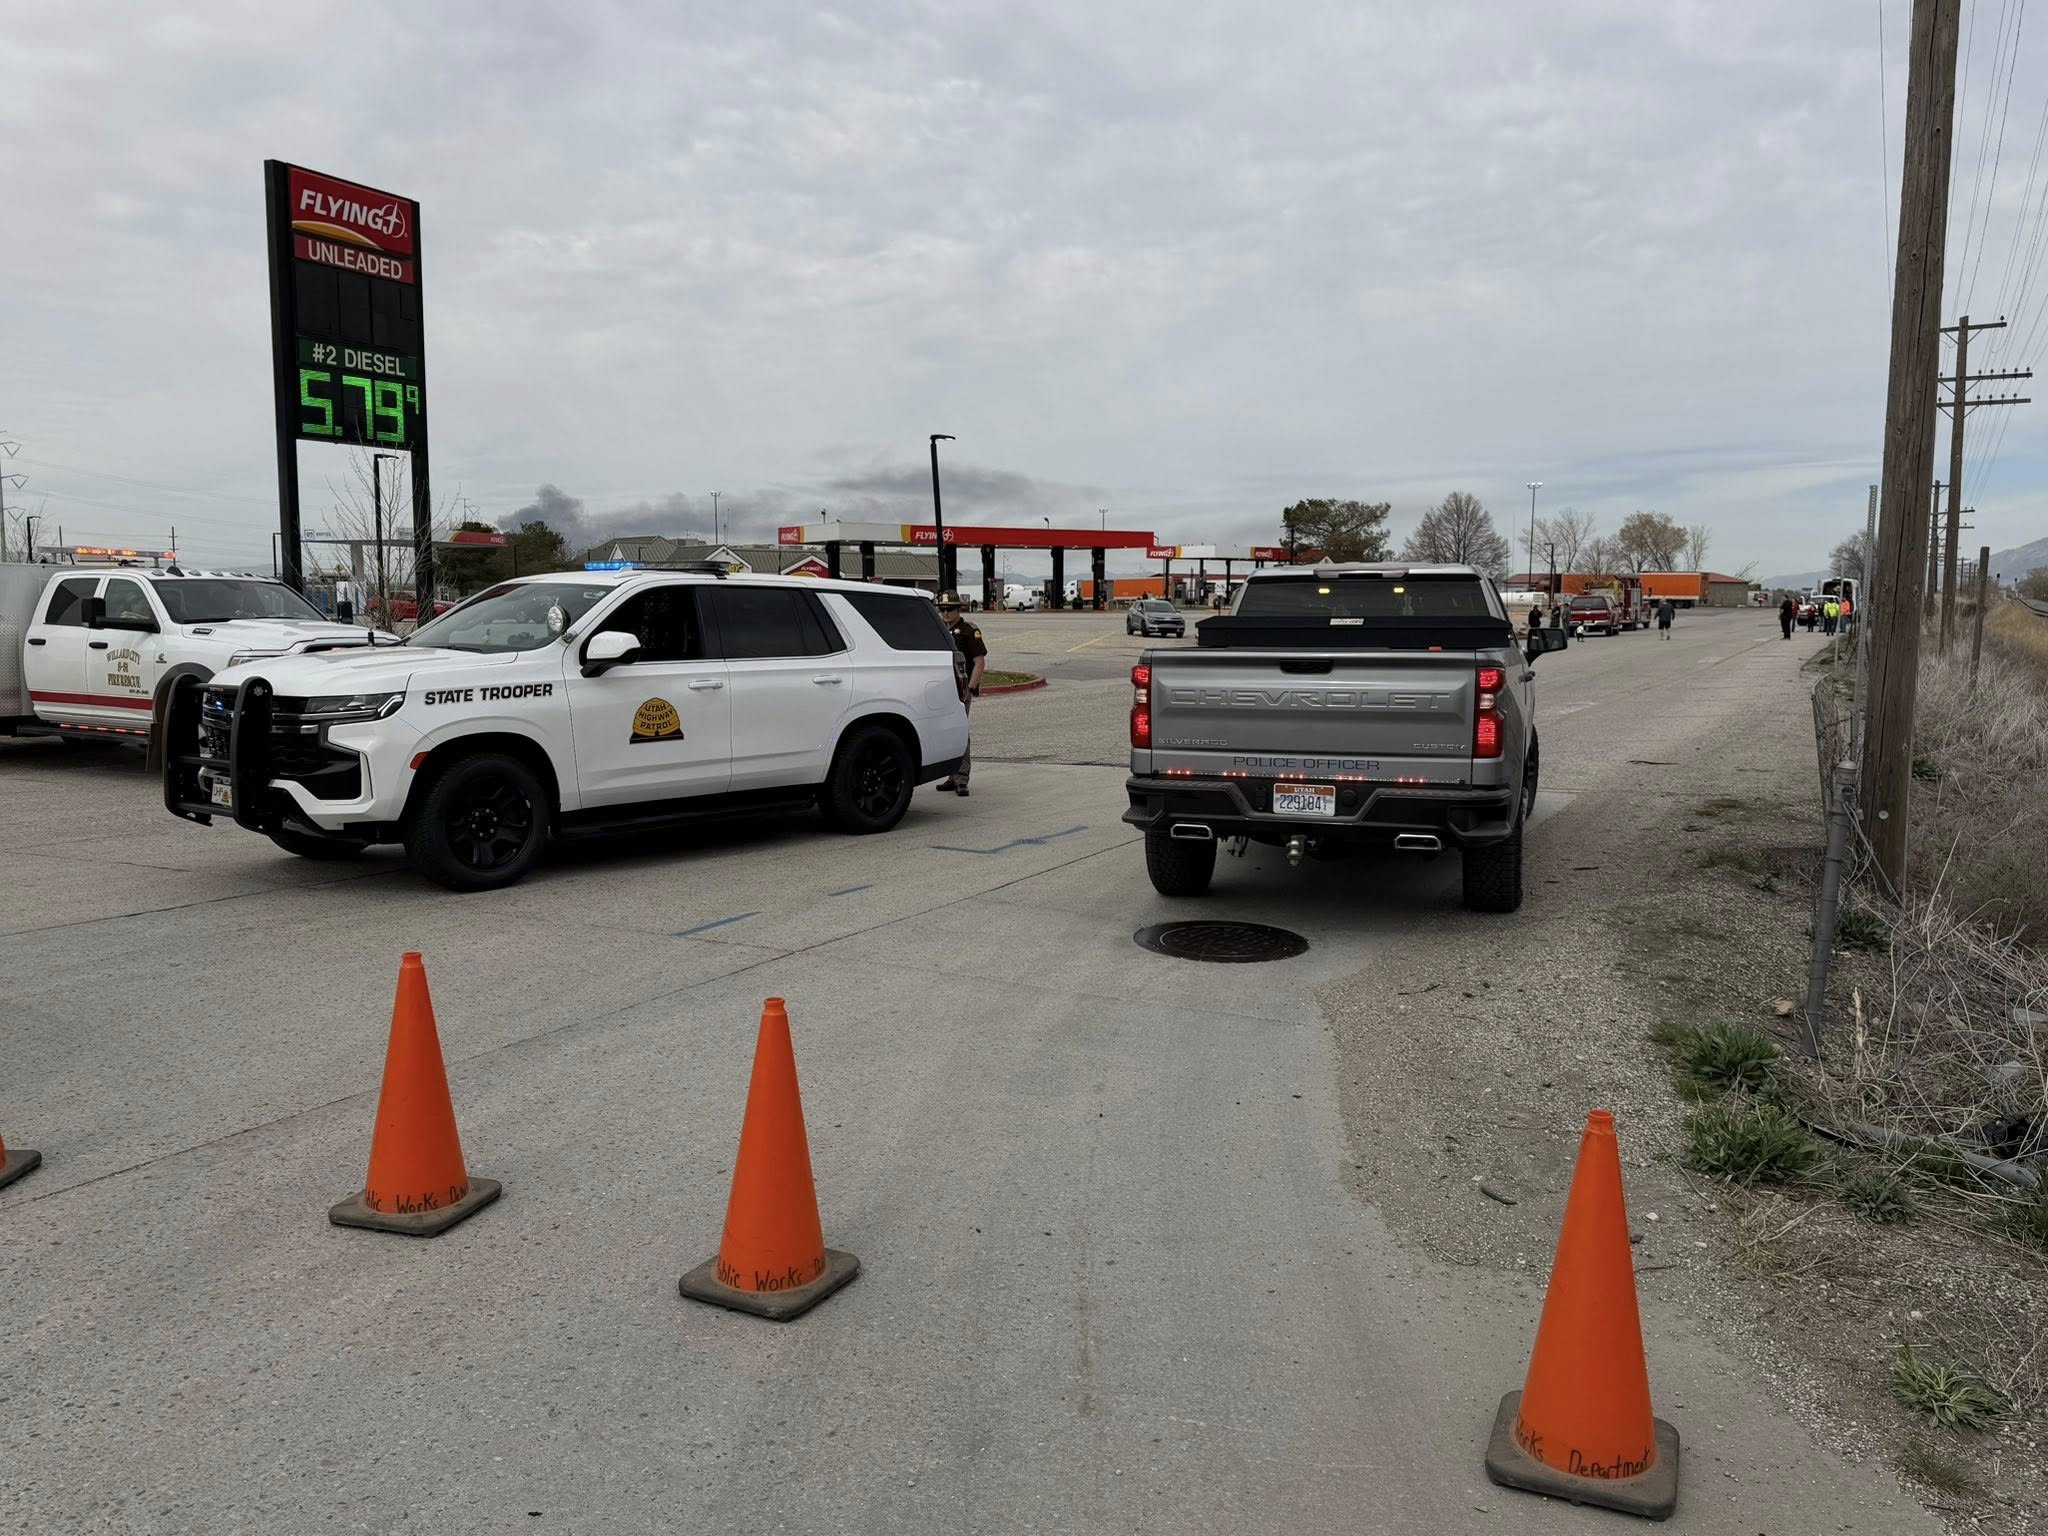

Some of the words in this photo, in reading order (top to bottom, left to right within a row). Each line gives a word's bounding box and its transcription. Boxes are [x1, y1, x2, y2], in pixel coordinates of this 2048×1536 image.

[308, 239, 403, 279] UNLEADED
[312, 342, 338, 365] #2
[344, 348, 406, 377] DIESEL
[424, 689, 474, 705] STATE
[480, 683, 553, 701] TROOPER
[1170, 689, 1451, 710] CHEVROLET
[638, 708, 673, 722] HIGHWAY
[644, 703, 667, 713] UTAH
[640, 720, 673, 731] PATROL
[1157, 737, 1229, 746] SILVERADO
[1413, 742, 1467, 751] CUSTOM
[1233, 756, 1297, 768] POLICE
[1303, 758, 1380, 771] OFFICER
